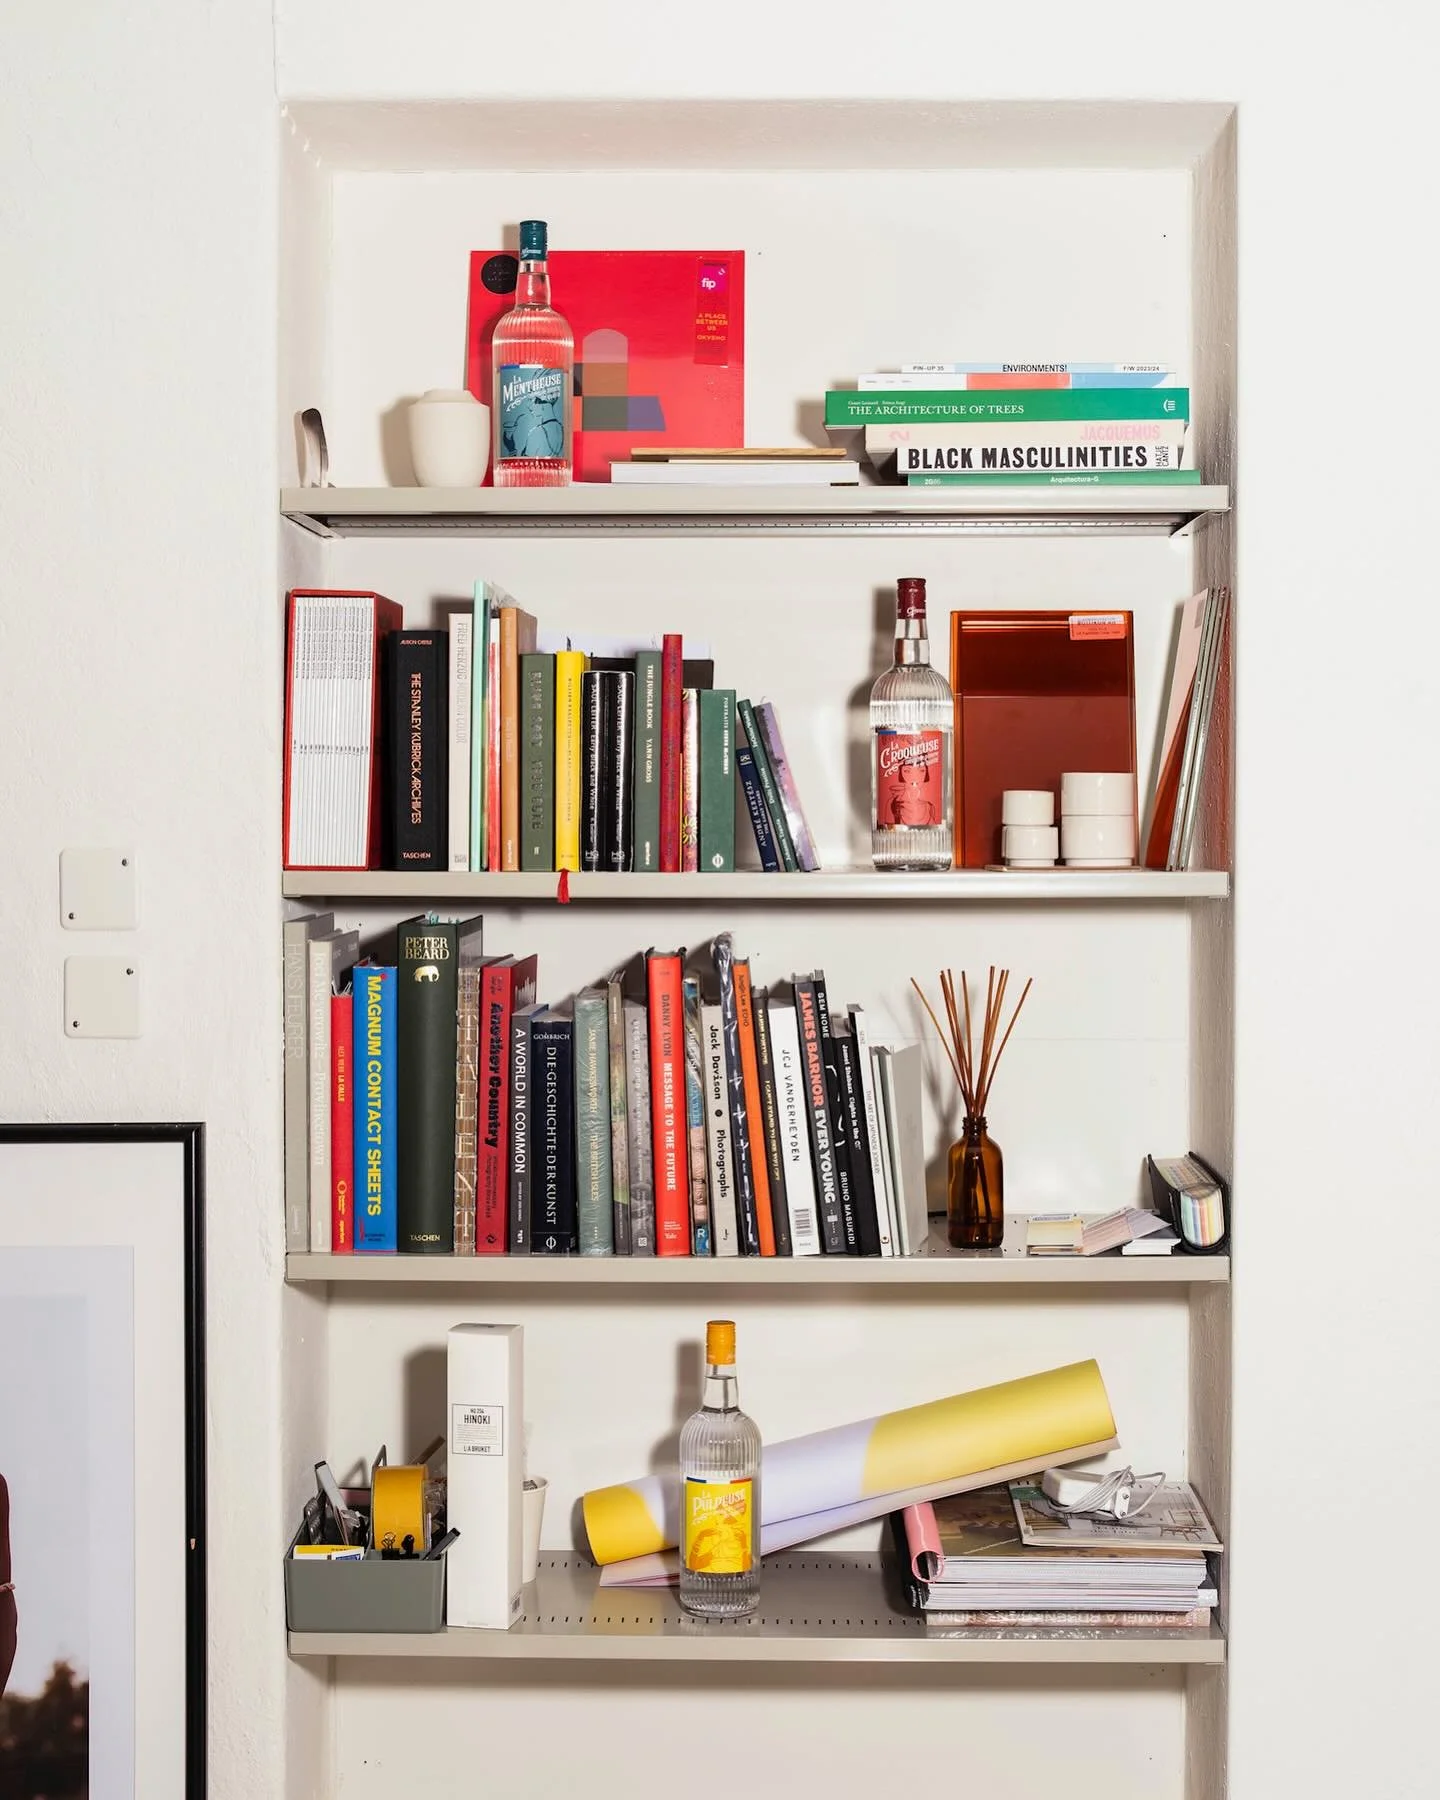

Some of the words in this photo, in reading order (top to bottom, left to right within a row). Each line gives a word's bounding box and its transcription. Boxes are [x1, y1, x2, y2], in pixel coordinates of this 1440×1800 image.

[701, 277, 716, 290] fip
[513, 375, 522, 384] LA
[1002, 364, 1068, 373] ENVIRONMENTS!
[848, 405, 872, 415] THE
[874, 404, 966, 415] ARCHITECTURE
[969, 404, 985, 414] OF
[987, 404, 1024, 414] TREES
[1080, 424, 1161, 440] JACQUEMUS
[907, 447, 972, 469] BLACK
[981, 445, 1148, 468] MASCULINITIES
[411, 672, 422, 688] THE
[647, 664, 655, 679] THE
[646, 680, 655, 708] JUNGLE
[411, 689, 422, 730] STANLEY
[646, 709, 654, 729] BOOK
[411, 732, 422, 774] KUBRICK
[646, 738, 654, 758] YANN
[880, 738, 940, 769] CROQUEUSE
[890, 741, 899, 750] LA
[645, 759, 653, 783] GROSS
[411, 776, 422, 824] ARCHIVES
[405, 936, 448, 949] PETER
[405, 948, 449, 960] BEARD
[287, 943, 304, 990] HANS
[366, 976, 382, 1056] MAGNUM
[662, 994, 671, 1028] DANNY
[799, 991, 817, 1041] JAMES
[489, 1002, 503, 1074] Another
[514, 1028, 526, 1038] A
[709, 1025, 721, 1051] Jack
[818, 1013, 830, 1039] NOME
[663, 1032, 672, 1057] LYON
[514, 1042, 526, 1091] WORLD
[782, 1049, 792, 1069] JCJ
[337, 1074, 345, 1083] LA
[663, 1062, 674, 1110] MESSAGE
[712, 1055, 723, 1100] Davison
[806, 1042, 825, 1107] BARNOR
[337, 1083, 345, 1102] CALLE
[366, 1060, 382, 1144] CONTACT
[514, 1096, 526, 1108] IN
[484, 1075, 502, 1149] Country
[665, 1112, 675, 1126] TO
[784, 1075, 800, 1162] VANDERHEYDEN
[514, 1112, 526, 1173] COMMON
[665, 1129, 675, 1149] THE
[814, 1109, 829, 1151] EVER
[666, 1152, 676, 1191] FUTURE
[716, 1129, 730, 1198] Photographs
[817, 1149, 836, 1204] YOUNG
[366, 1149, 382, 1216] SHEETS
[840, 1171, 850, 1201] BRUNO
[844, 1204, 855, 1245] MASUKIDI
[463, 1414, 491, 1425] HINOKI
